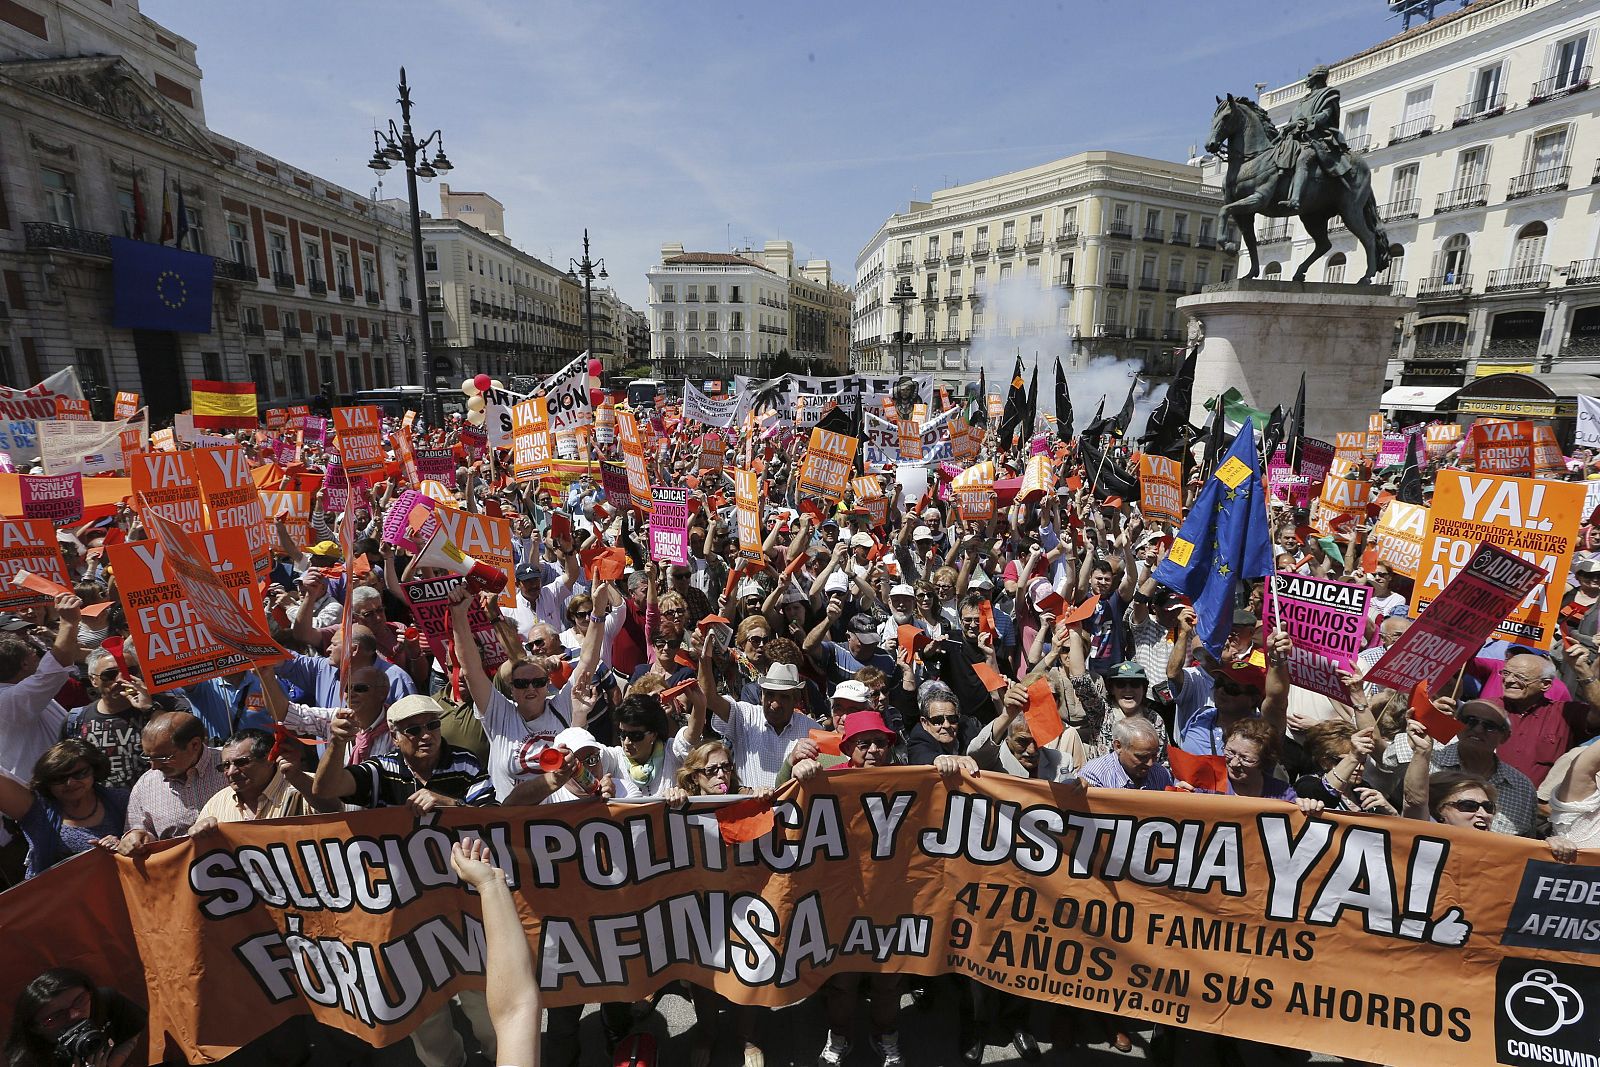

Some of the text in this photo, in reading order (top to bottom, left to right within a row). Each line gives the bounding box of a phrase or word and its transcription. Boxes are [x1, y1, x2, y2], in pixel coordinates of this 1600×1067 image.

[1412, 368, 1450, 376] PALAZZO
[62, 401, 83, 411] YA!
[120, 392, 135, 402] YA!
[1470, 402, 1521, 412] TOURIST BUS
[340, 408, 370, 428] YA!
[516, 400, 539, 426] YA!
[898, 420, 920, 437] YA!
[1428, 425, 1457, 441] YA!
[1483, 423, 1519, 442] YA!
[342, 435, 378, 450] FORUM
[515, 431, 547, 451] FORUM
[705, 440, 720, 451] YA!
[819, 431, 848, 455] YA!
[1336, 432, 1362, 448] YA!
[345, 447, 382, 462] AFINSA
[424, 450, 452, 459] ADICAE
[516, 445, 549, 465] AFINSA
[1336, 450, 1362, 458] FORUM
[1479, 447, 1530, 460] FORUM
[144, 454, 188, 490] YA!
[808, 455, 848, 476] FORUM
[1147, 456, 1174, 480] YA!
[1300, 460, 1325, 472] FORUM
[1480, 458, 1531, 470] AFINSA
[31, 480, 75, 491] AFINSA
[805, 467, 844, 487] AFINSA
[852, 476, 881, 497] YA!
[31, 490, 75, 501] FORUM
[659, 490, 686, 502] ADICAE
[1144, 483, 1180, 500] FORUM
[1326, 475, 1362, 507] YA!
[259, 492, 304, 518] YA!
[654, 503, 686, 517] XIGIMOS
[962, 502, 990, 513] FINSA
[1144, 494, 1180, 513] AFINSA
[1458, 475, 1546, 531] YA!
[384, 492, 416, 540] SOLUCION
[651, 515, 686, 529] SOLUCION
[1388, 502, 1427, 537] YA
[436, 507, 501, 557] YA!
[654, 530, 682, 547] FORUM
[1433, 524, 1566, 555] PARA FAMILIAS
[1434, 518, 1474, 531] SOLUCIÓN
[1475, 523, 1513, 538] POLÍTICA
[1523, 530, 1568, 546] JUSTICIA
[654, 542, 682, 557] AFINSA
[1484, 556, 1540, 592] ADICAE
[127, 571, 250, 600] SOLUCIÓN USTICIA
[1288, 578, 1366, 607] ADICAE
[130, 595, 161, 609] PARA
[1447, 581, 1511, 618] EXIGIMOS
[1268, 599, 1359, 634] EXIGIMOS
[1403, 631, 1466, 666] FORUM
[1288, 661, 1342, 691] FINSA
[1388, 651, 1446, 684] AFINSA
[190, 811, 518, 920] SOLUCIÓN
[861, 792, 916, 861] Y
[920, 789, 1245, 897] JUSTICIA
[1258, 813, 1450, 941] YA!
[955, 882, 1317, 962] 470.000 FAMILIAS
[1518, 914, 1600, 941] AFINS
[236, 890, 931, 1025] FÓRUM AFINSA, AyN
[945, 952, 1191, 1024] www.solucionya.org
[949, 918, 1473, 1043] 9 AÑOS SIN SUS AHORROS
[1507, 1039, 1600, 1067] CONSUMID
